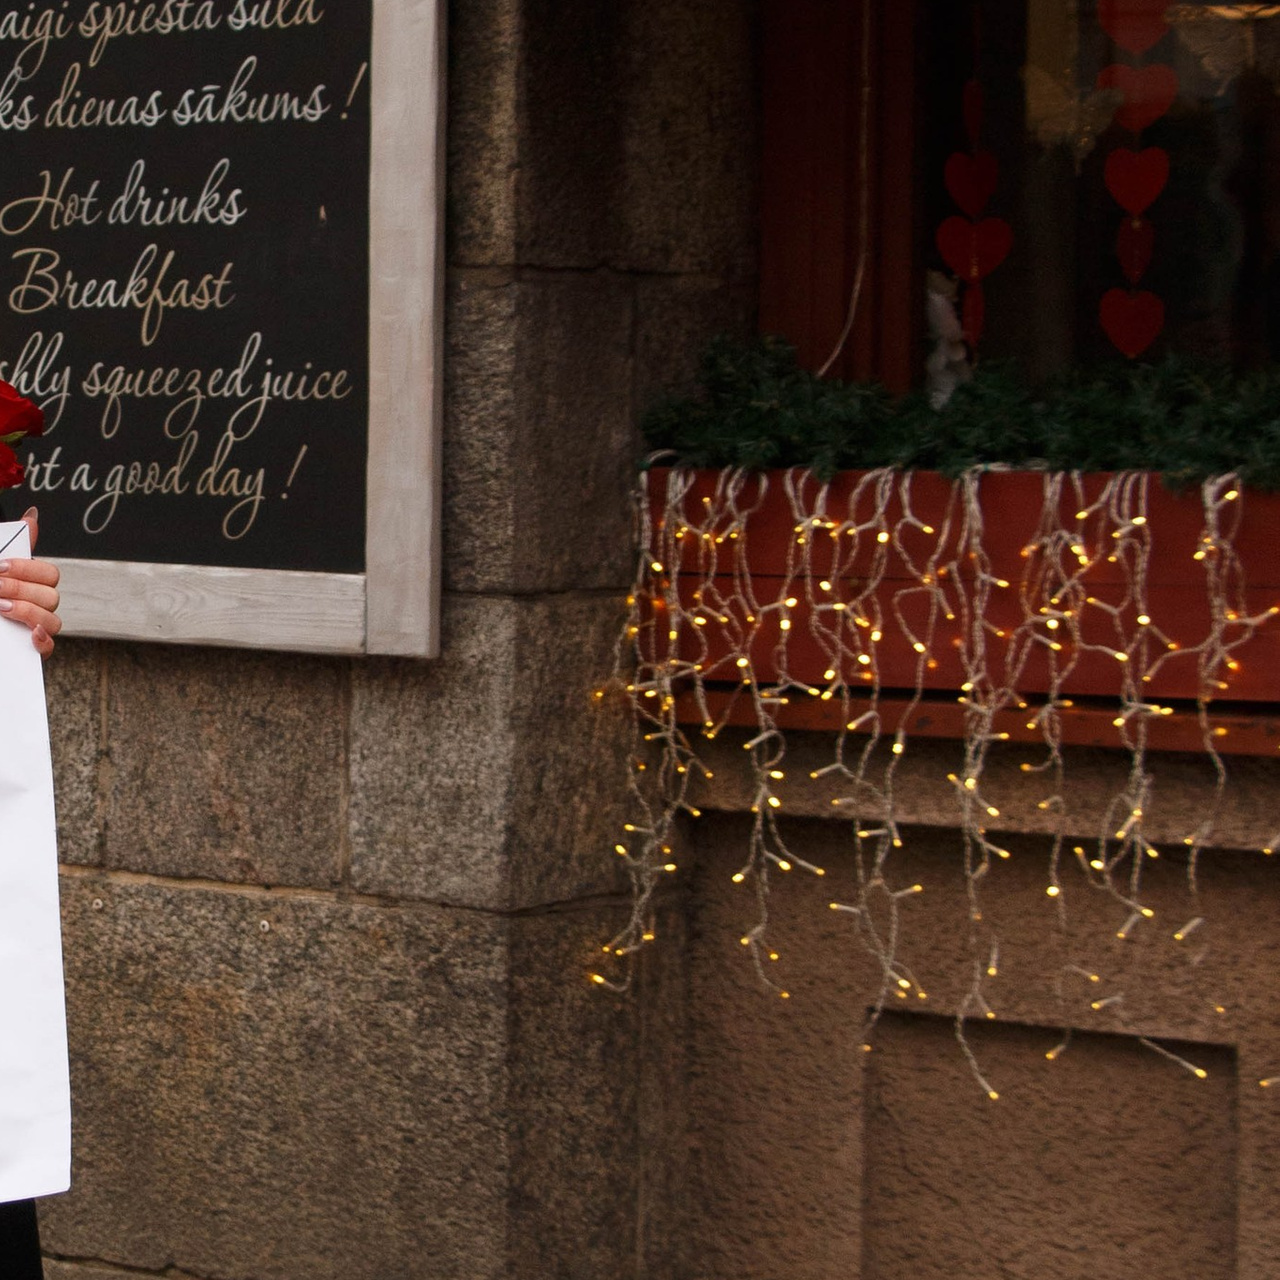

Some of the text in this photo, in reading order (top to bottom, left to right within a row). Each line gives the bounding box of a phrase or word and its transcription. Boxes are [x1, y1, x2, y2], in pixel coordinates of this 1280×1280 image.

[44, 62, 168, 127] dienas
[172, 55, 330, 124] sākums
[108, 159, 247, 226] drinks
[8, 243, 235, 346] Breakfast
[82, 331, 261, 439] squeezed
[226, 361, 353, 441] juice
[70, 463, 98, 491] a
[82, 430, 190, 535] good
[195, 431, 266, 540] day
